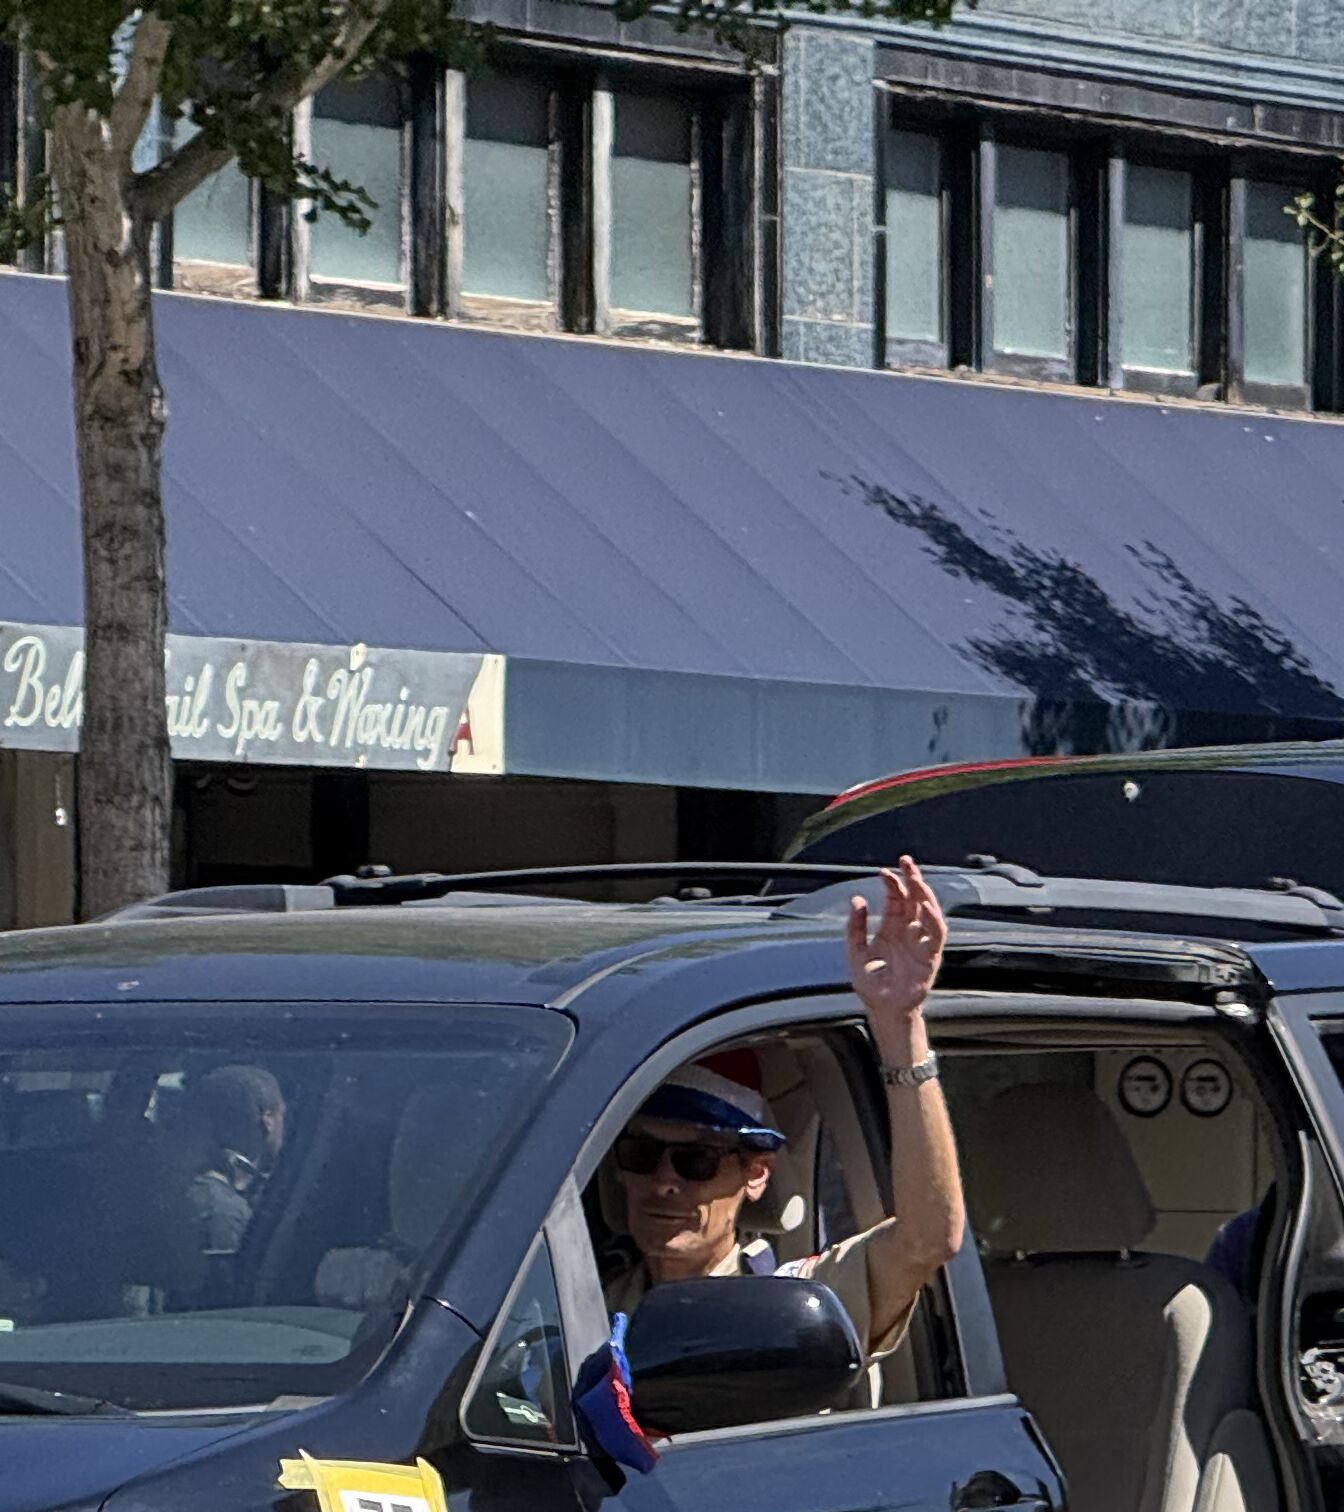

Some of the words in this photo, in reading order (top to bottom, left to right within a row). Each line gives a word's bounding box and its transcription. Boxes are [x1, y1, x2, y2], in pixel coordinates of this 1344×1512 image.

[217, 661, 285, 755] Spa
[293, 657, 325, 743] &
[326, 666, 450, 770] Waxing
